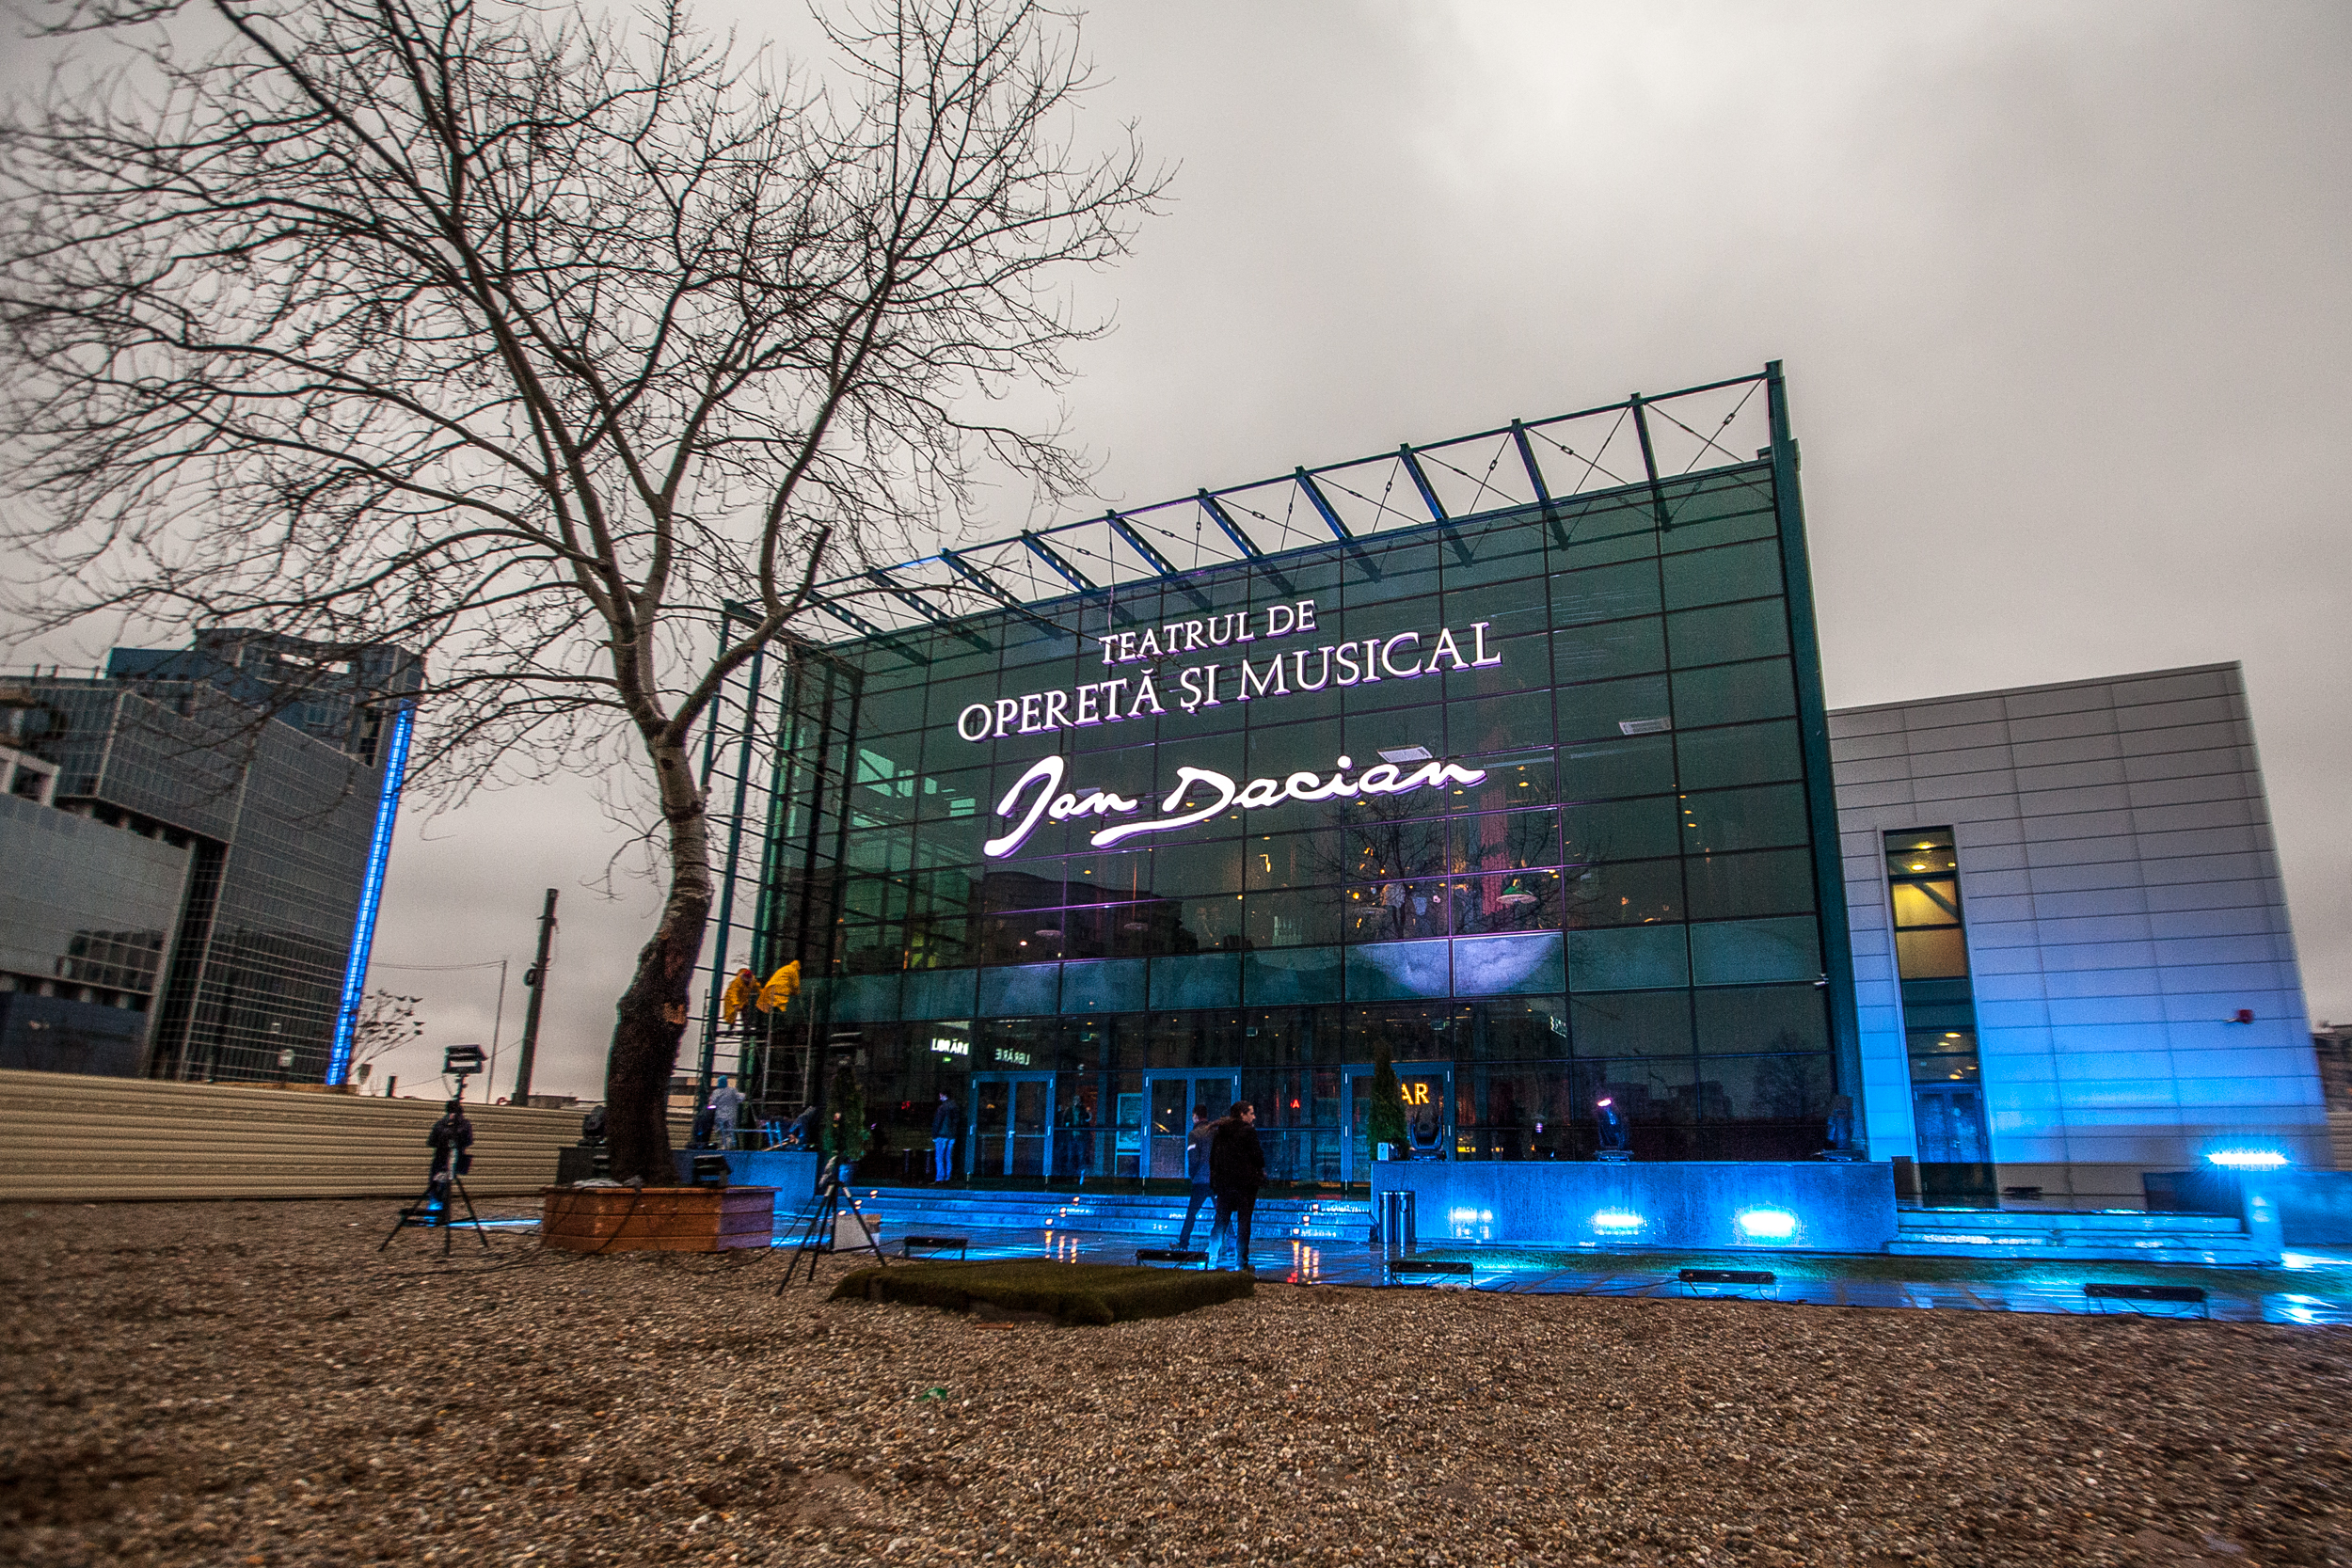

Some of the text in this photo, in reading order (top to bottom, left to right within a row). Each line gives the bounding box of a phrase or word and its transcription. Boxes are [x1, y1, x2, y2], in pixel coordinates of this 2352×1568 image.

[1098, 599, 1317, 665] TEATRUL DE
[1237, 622, 1502, 700] MUSICAL
[1090, 755, 1486, 846] Dacian
[1401, 1083, 1430, 1105] AR
